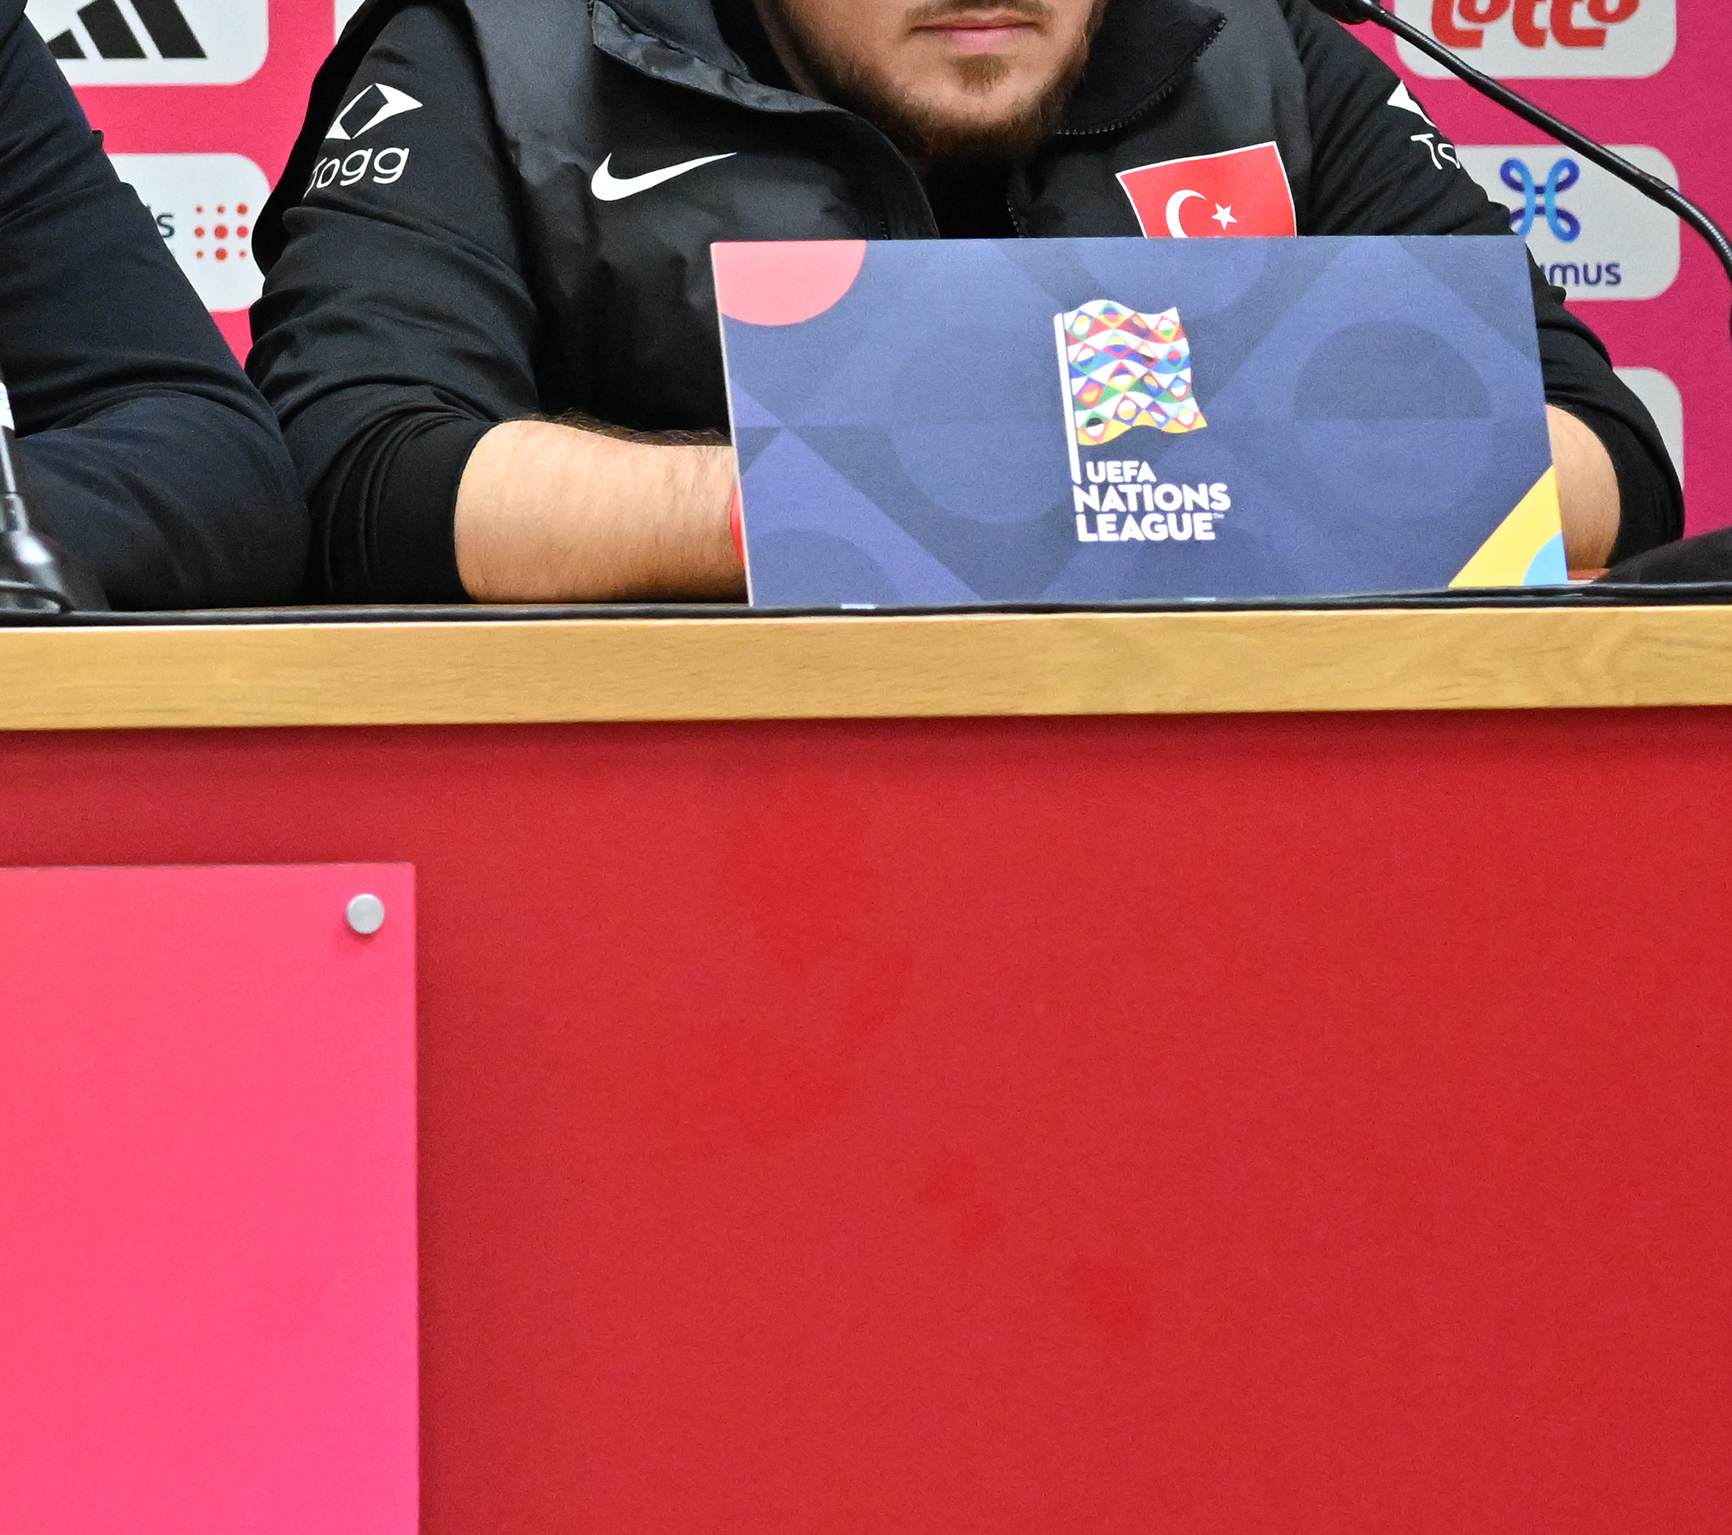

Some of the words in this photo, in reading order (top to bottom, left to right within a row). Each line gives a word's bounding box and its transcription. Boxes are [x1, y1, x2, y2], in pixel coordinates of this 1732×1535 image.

[1085, 459, 1158, 484] UEFA
[1072, 482, 1232, 512] NATIONS
[1075, 512, 1217, 543] LEAGUE
